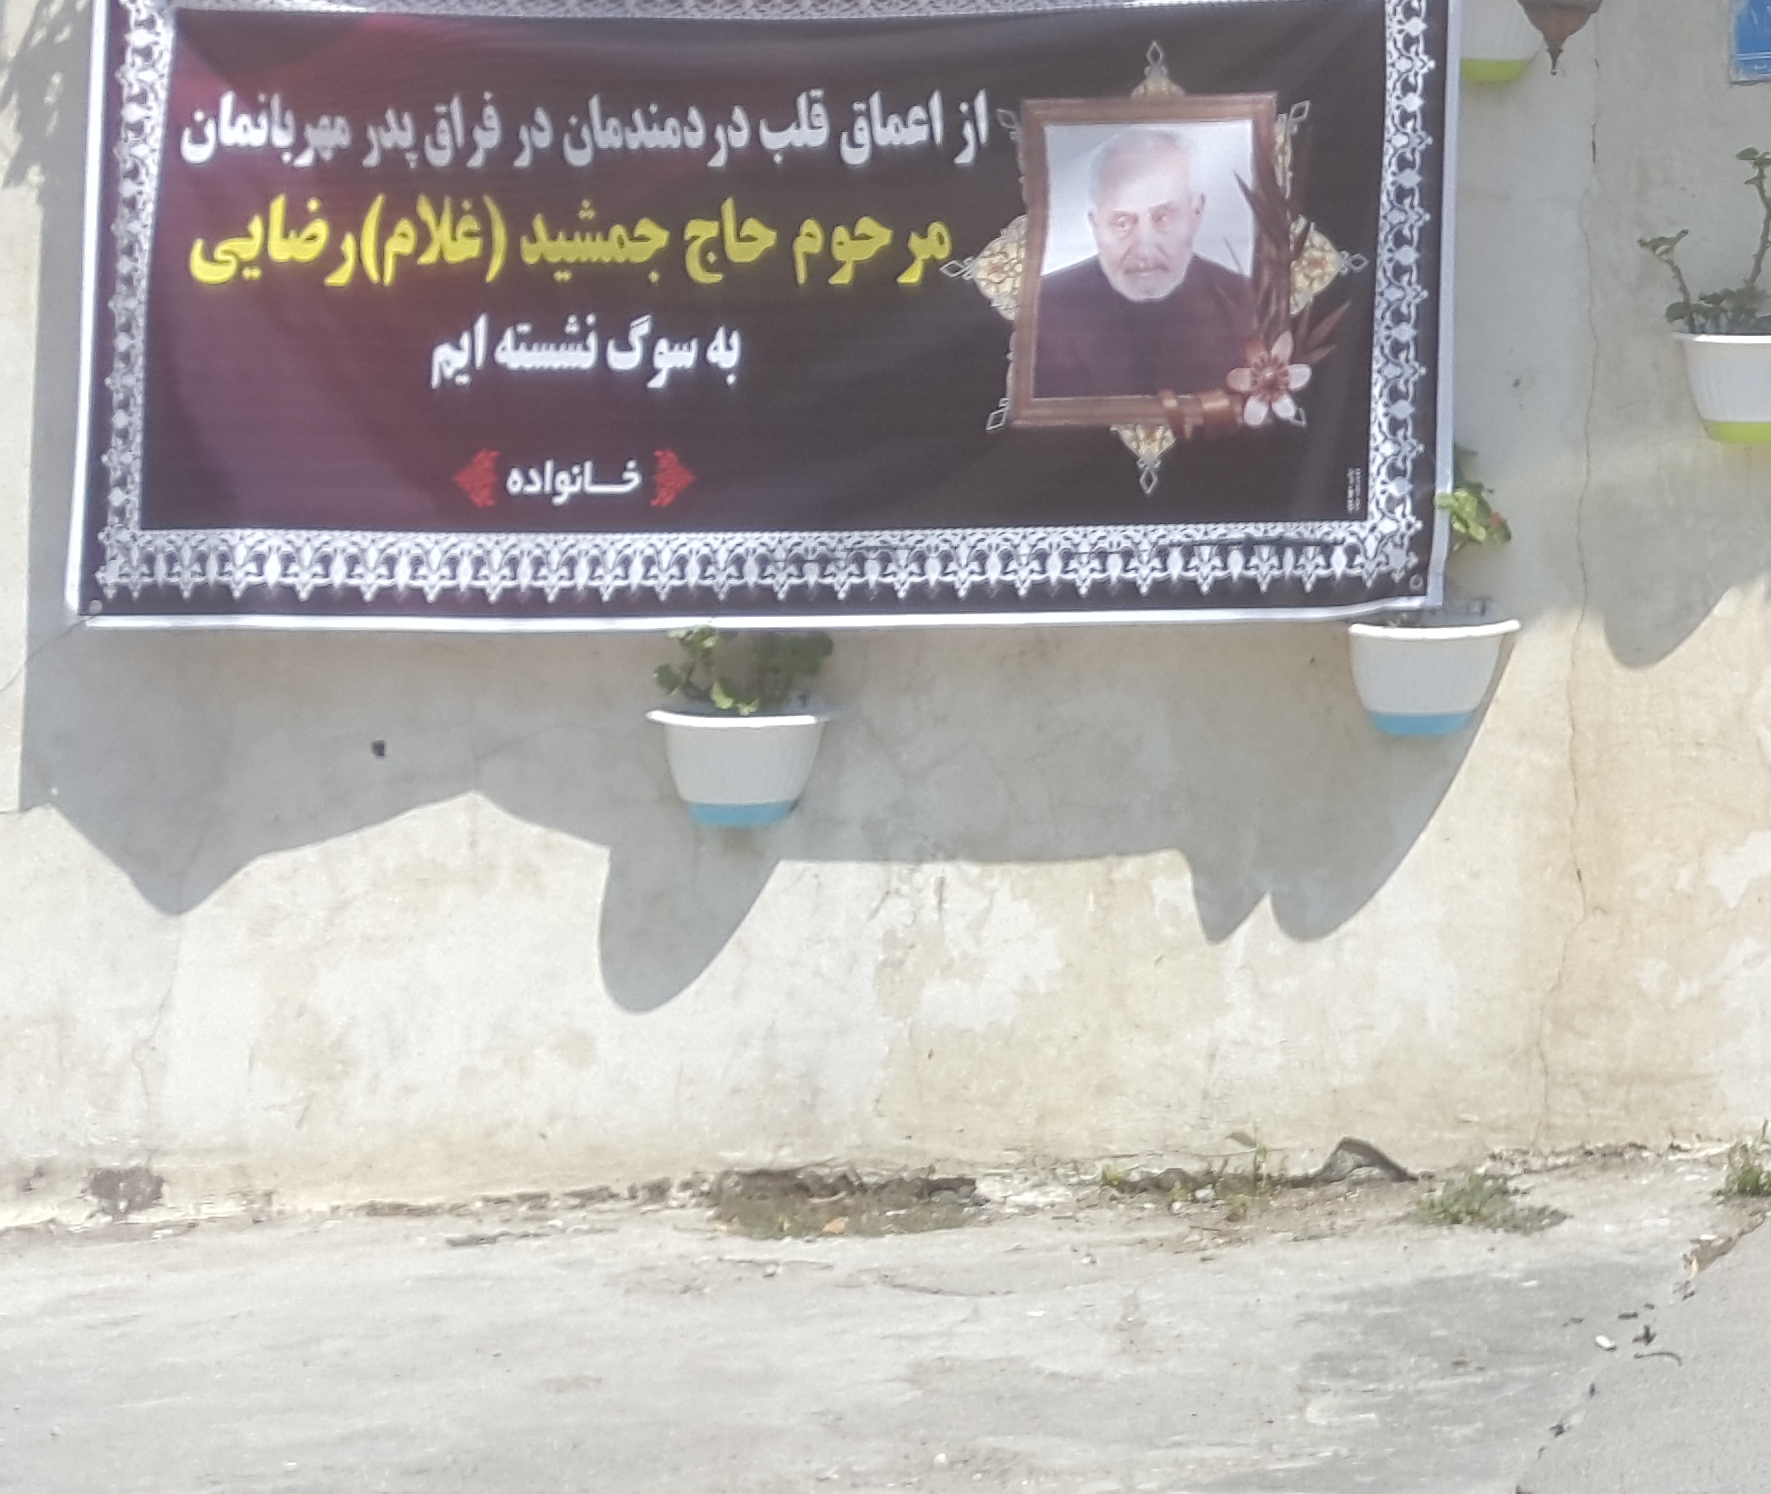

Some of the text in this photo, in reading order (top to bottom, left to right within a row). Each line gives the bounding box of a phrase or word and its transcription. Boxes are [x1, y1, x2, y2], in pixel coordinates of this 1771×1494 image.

[180, 89, 353, 166] مهربانمان
[362, 107, 416, 169] پدر
[424, 91, 502, 168] فراق
[513, 107, 554, 168] در
[759, 88, 831, 164] قلب
[840, 90, 944, 166] اعماق
[953, 88, 989, 165] از
[519, 200, 670, 284] جمشید
[684, 197, 778, 284] حاج
[793, 215, 953, 285] مرحوم
[431, 312, 742, 389] به سوگ نشسته ایم
[506, 458, 643, 507] خانواده
